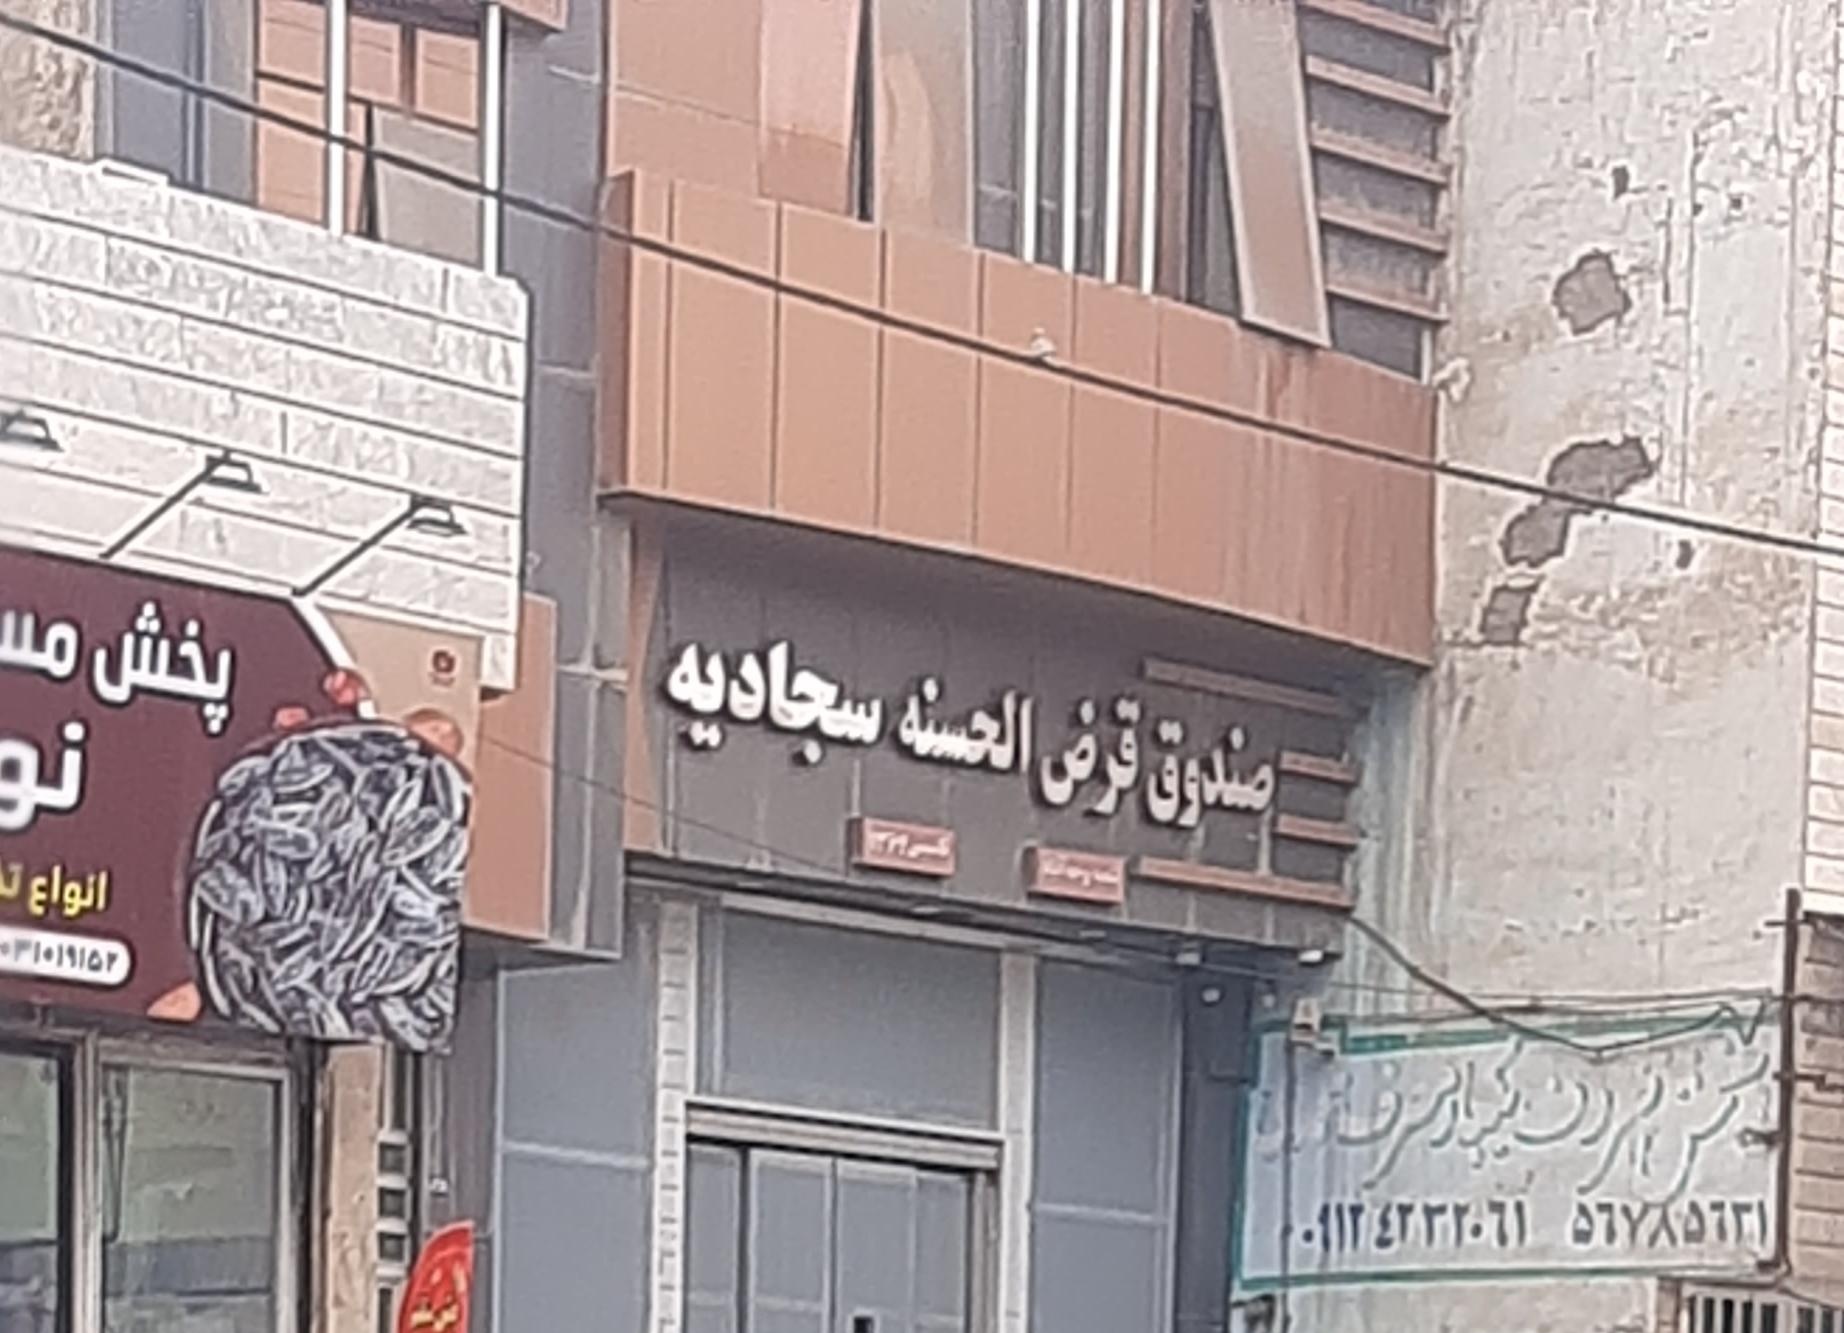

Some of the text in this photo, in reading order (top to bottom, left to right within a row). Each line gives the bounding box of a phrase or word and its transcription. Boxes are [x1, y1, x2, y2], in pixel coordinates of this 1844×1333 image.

[93, 601, 232, 735] پخش
[667, 639, 1275, 829] صندوق قرض الحسنه سجادیه
[28, 864, 109, 918] انواع
